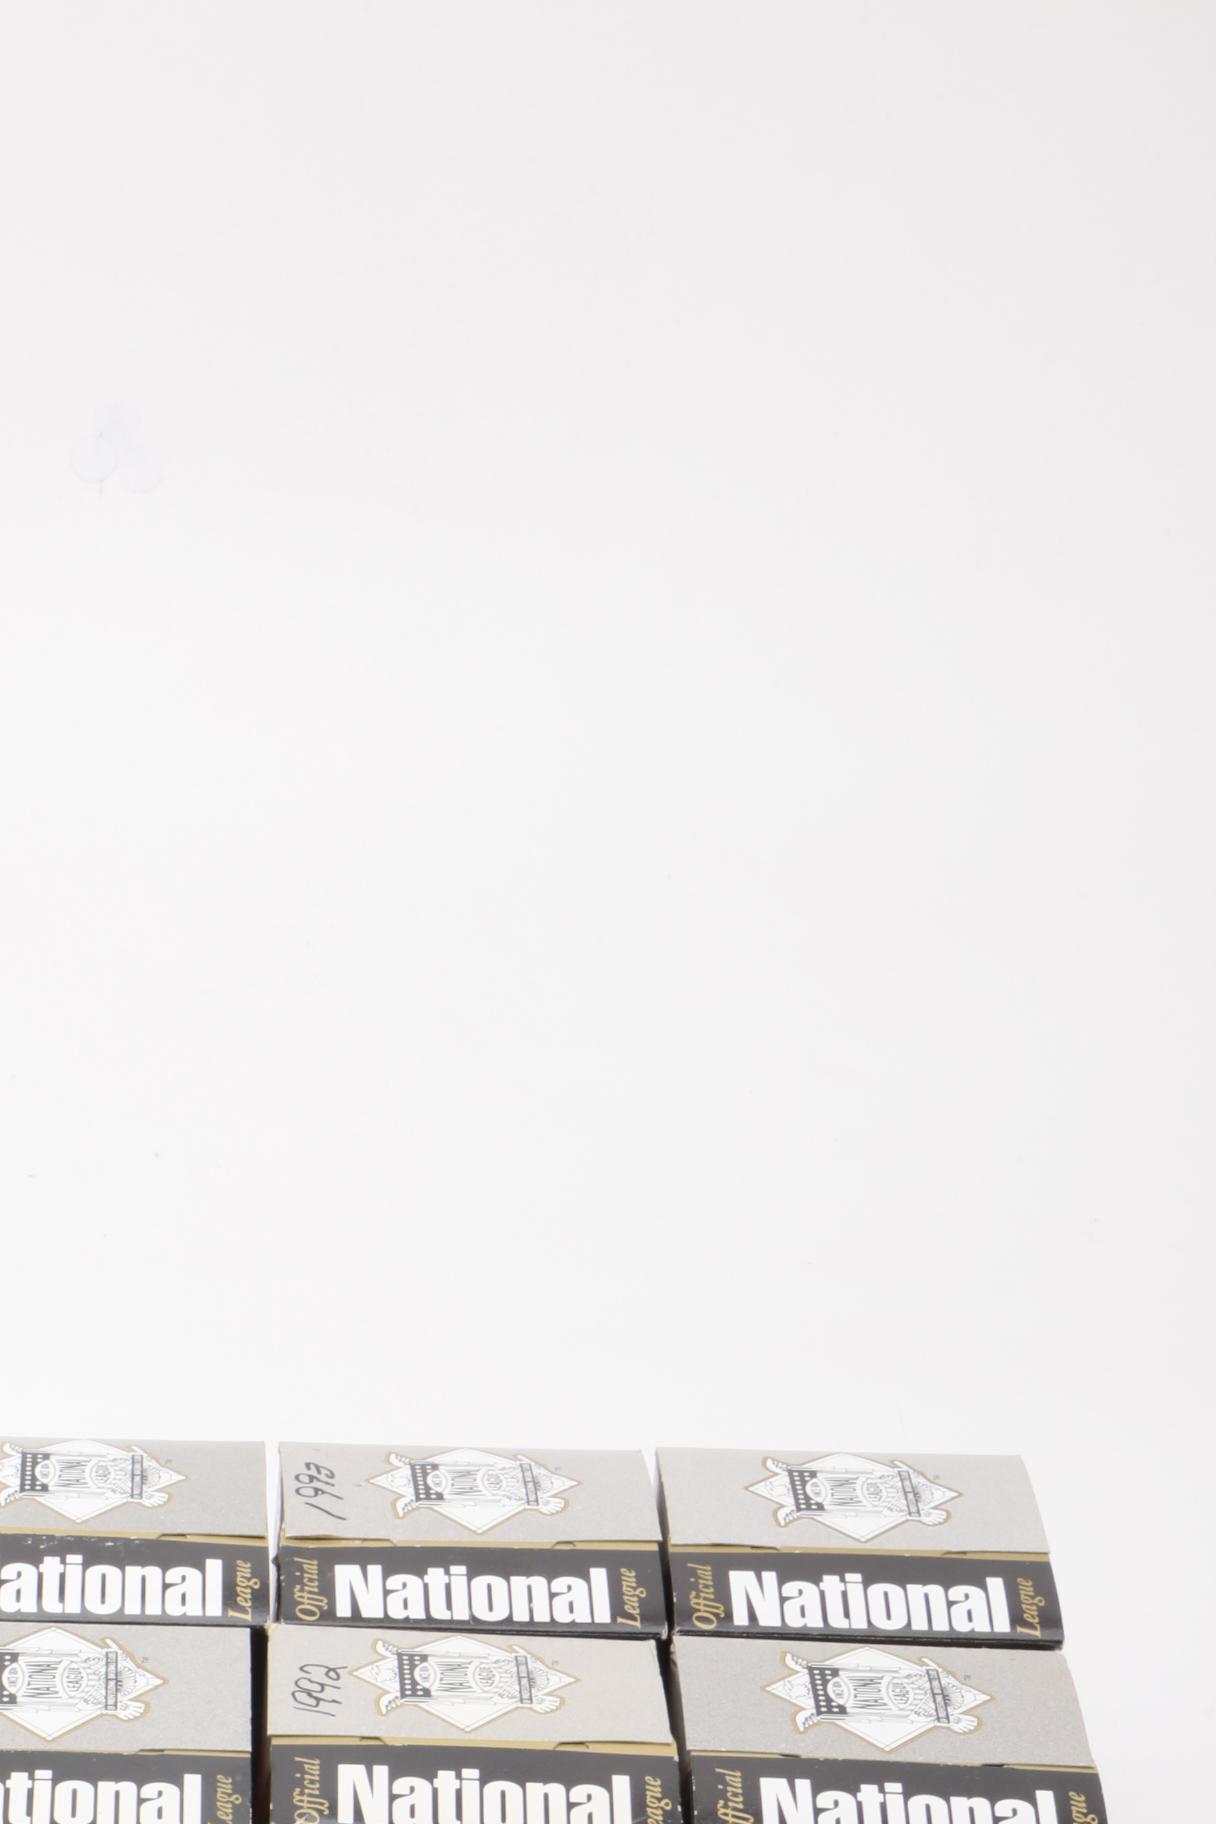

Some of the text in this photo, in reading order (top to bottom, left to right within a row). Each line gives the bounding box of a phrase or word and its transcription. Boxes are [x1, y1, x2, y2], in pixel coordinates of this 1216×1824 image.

[295, 1462, 347, 1521] 1993
[228, 1560, 257, 1622] League
[295, 1557, 648, 1628] Official National League
[687, 1563, 1046, 1638] Official National League
